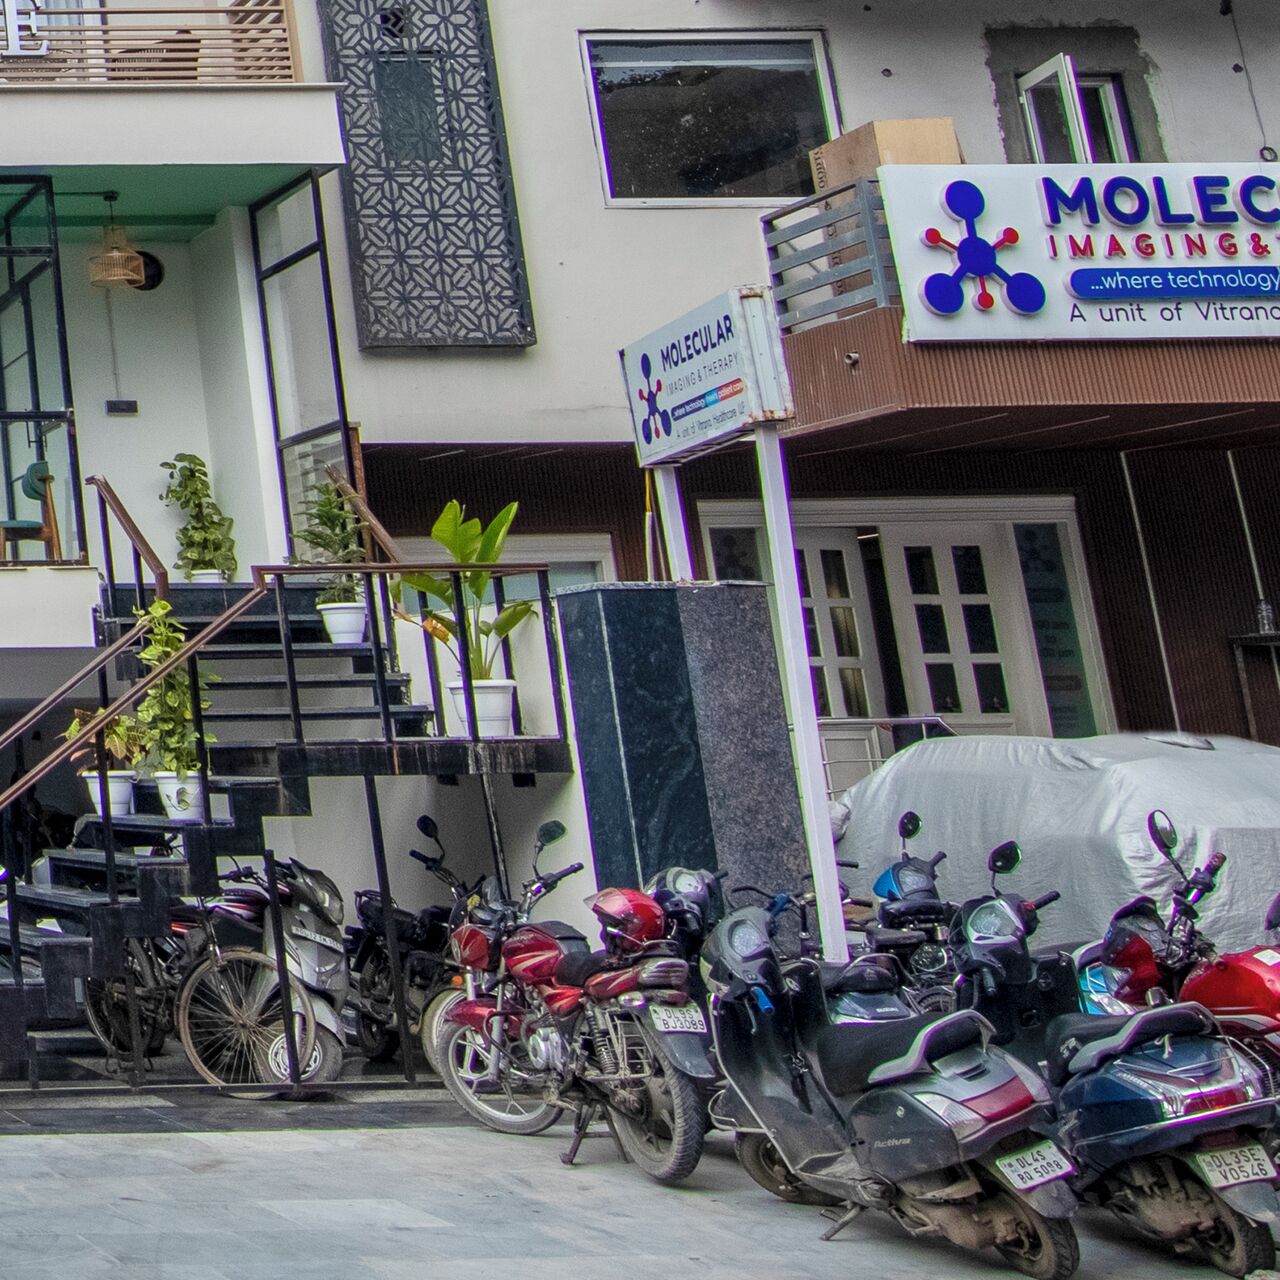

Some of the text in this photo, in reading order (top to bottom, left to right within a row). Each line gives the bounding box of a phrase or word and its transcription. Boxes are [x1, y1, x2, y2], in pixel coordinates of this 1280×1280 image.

[1039, 174, 1280, 226] MOLEC
[1044, 232, 1271, 260] IMAGING &
[1167, 269, 1280, 291] technology
[1069, 303, 1087, 322] A
[1099, 302, 1146, 322] unit
[1160, 301, 1183, 322] of
[660, 314, 735, 372] MOLECULAR
[666, 373, 697, 397] IMAGING
[702, 351, 739, 380] THERAPY
